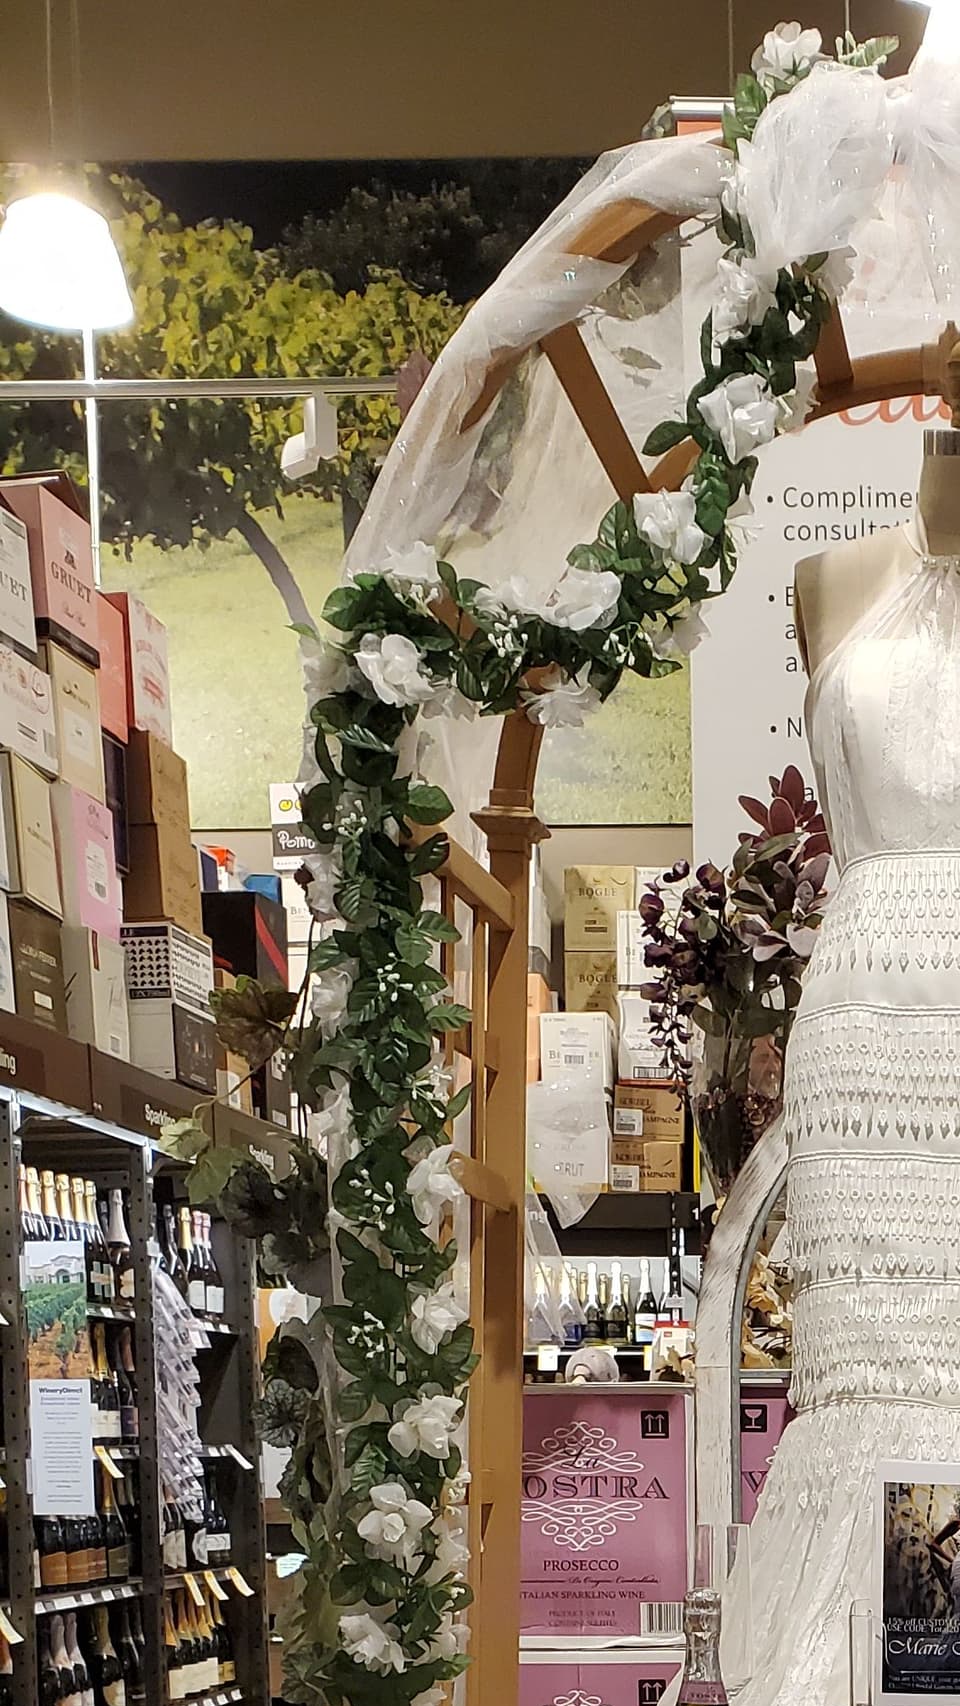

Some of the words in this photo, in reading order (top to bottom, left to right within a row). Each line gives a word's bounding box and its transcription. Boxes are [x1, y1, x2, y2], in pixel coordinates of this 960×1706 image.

[783, 486, 918, 514] Complime
[51, 561, 91, 604] GRUET
[578, 887, 617, 897] BOGLE
[578, 973, 617, 984] BOGLE
[521, 1475, 671, 1500] OSTRA
[543, 1559, 619, 1572] PROSECCO
[520, 1591, 559, 1599] TALIAN
[561, 1591, 616, 1600] SPARKLING
[619, 1591, 645, 1599] WINE
[888, 1637, 949, 1656] Marie
